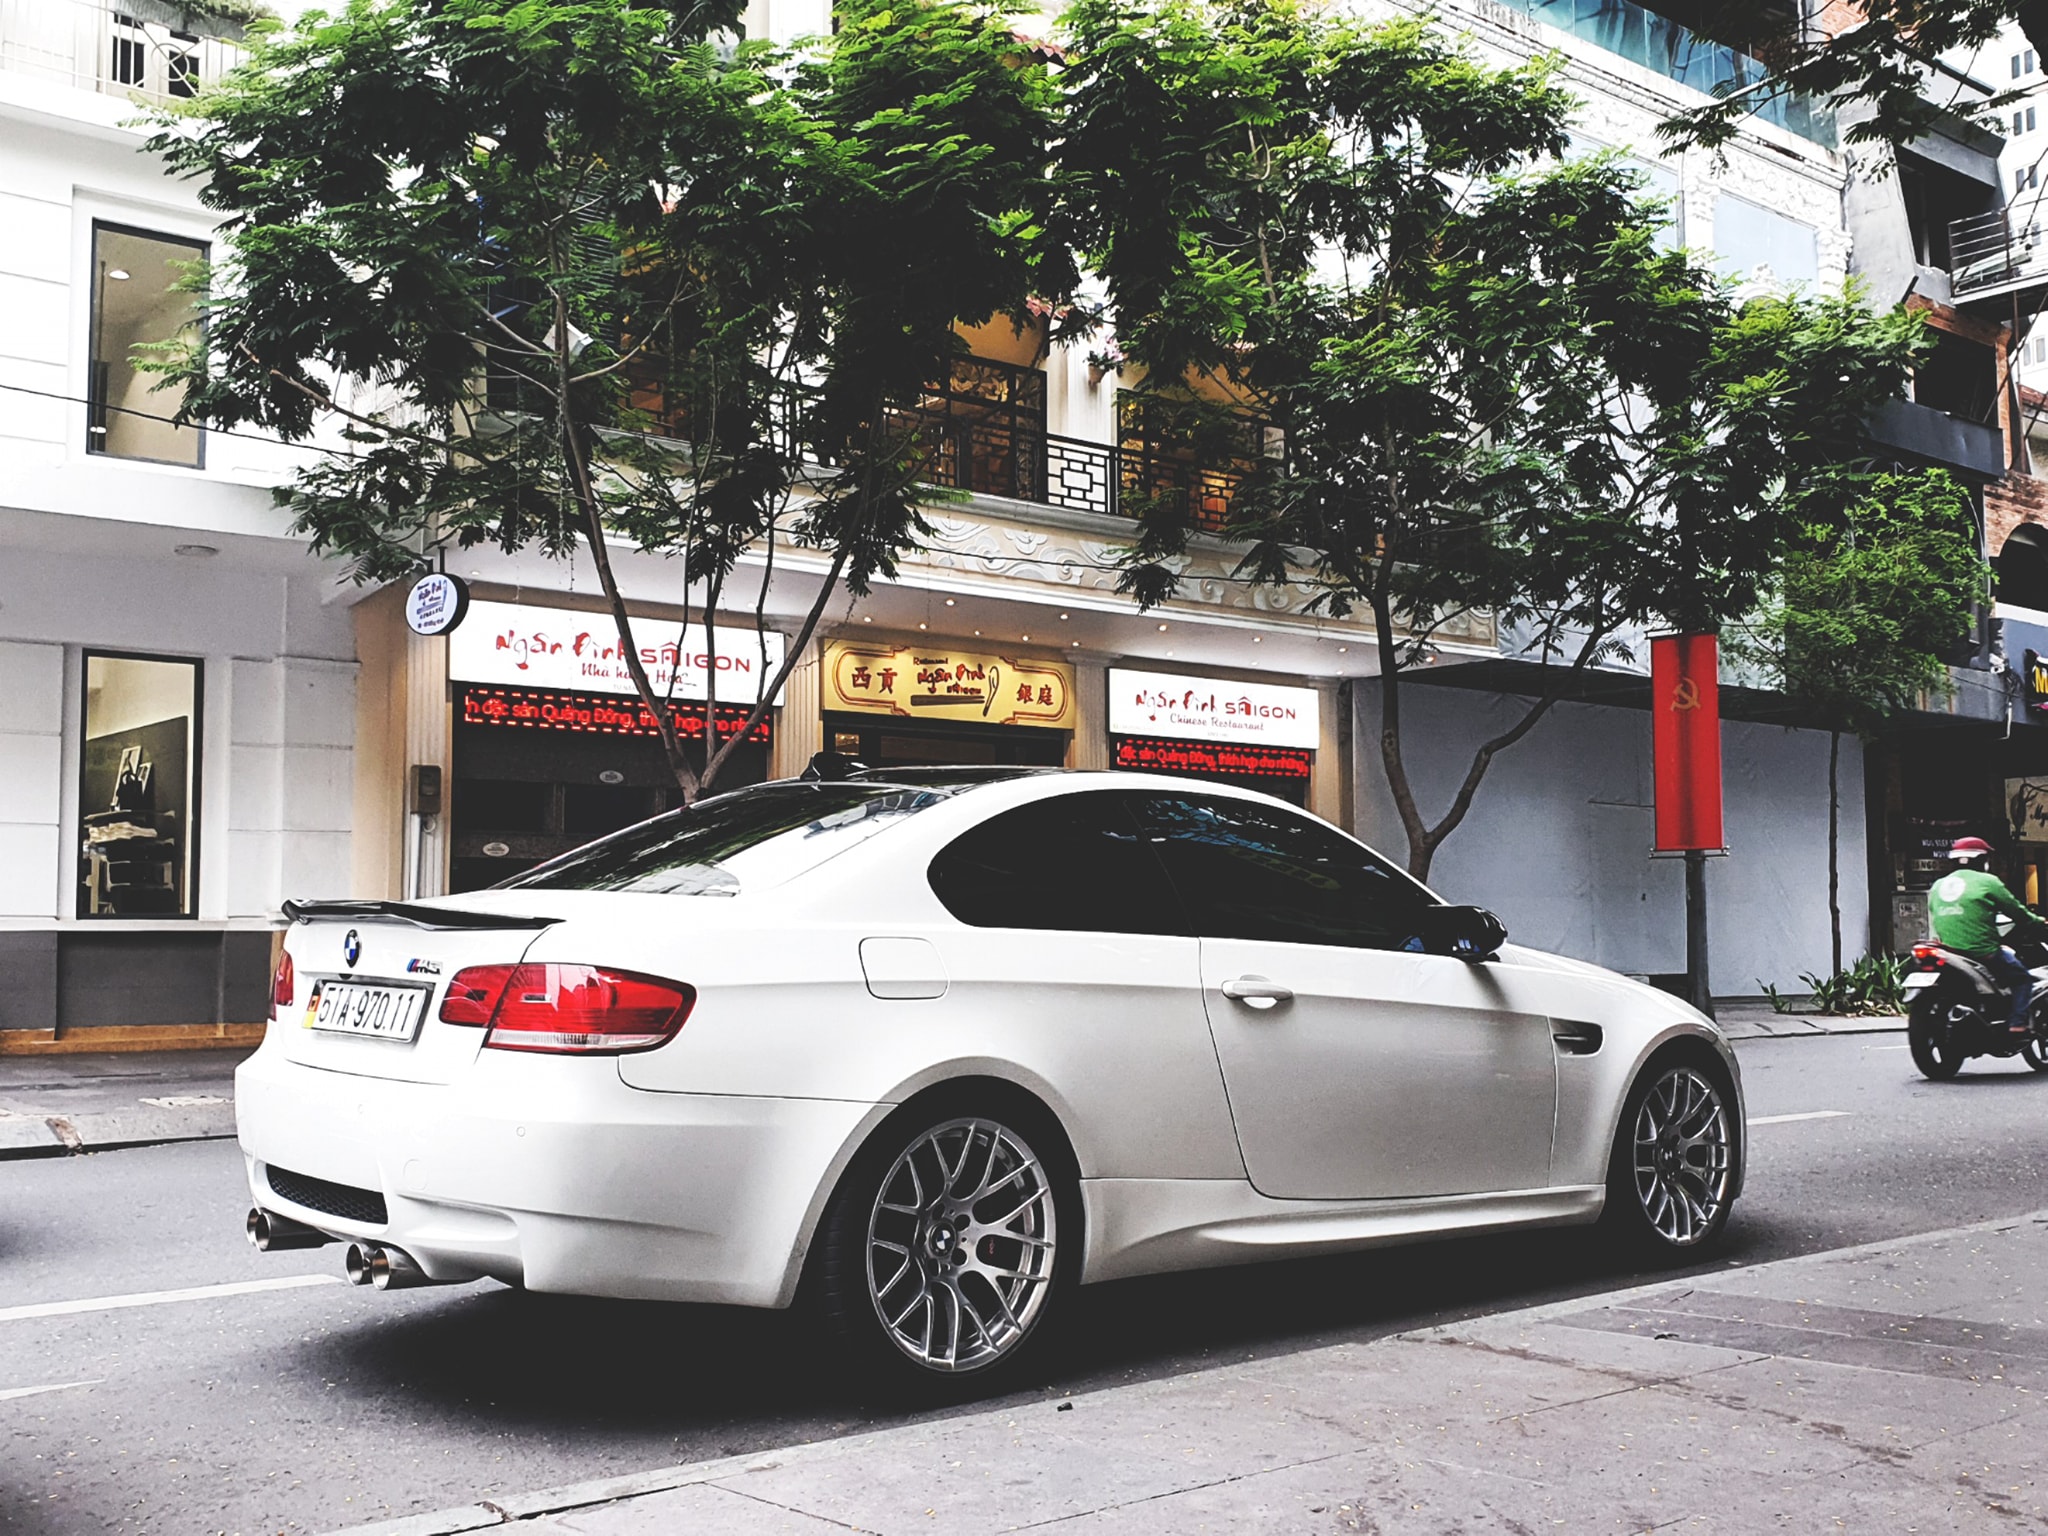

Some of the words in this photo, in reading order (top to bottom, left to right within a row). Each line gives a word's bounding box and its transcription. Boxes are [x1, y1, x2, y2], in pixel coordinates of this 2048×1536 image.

[851, 666, 898, 694] 西貢
[1016, 682, 1054, 706] 銀庭
[1170, 713, 1208, 727] Chinese
[1211, 716, 1265, 732] Restaurant
